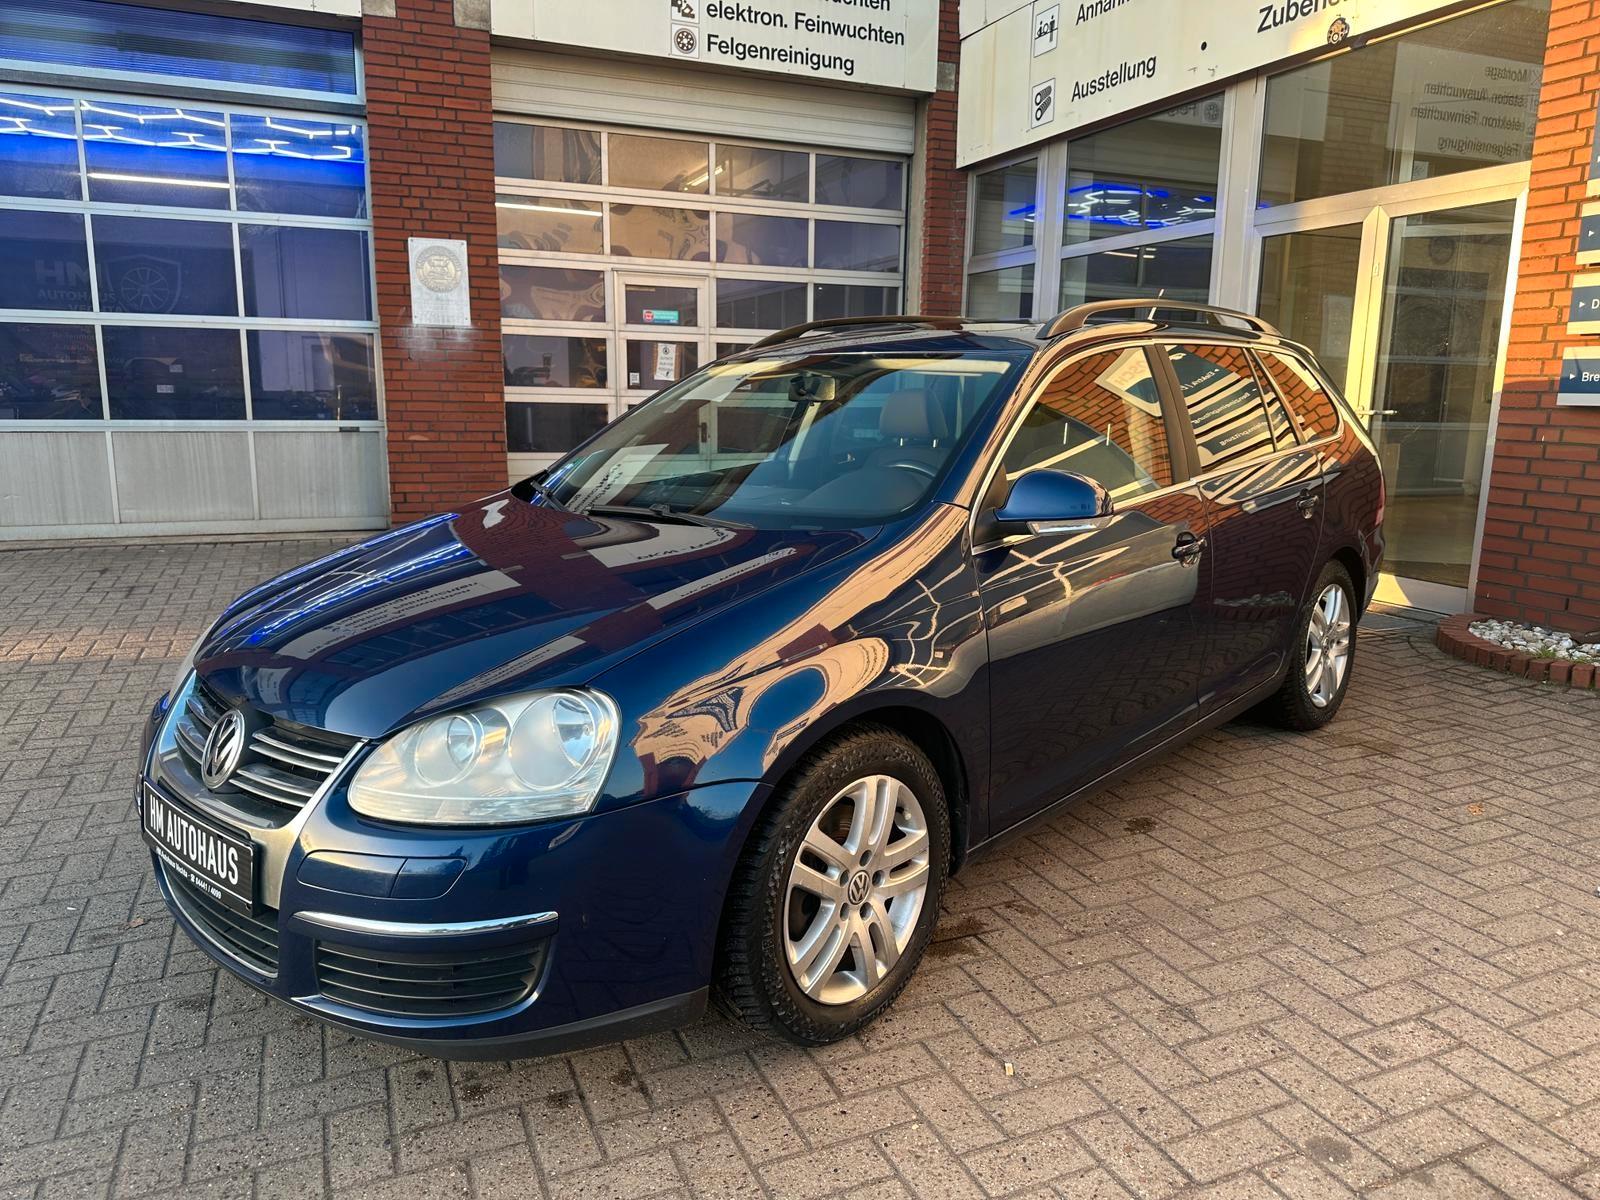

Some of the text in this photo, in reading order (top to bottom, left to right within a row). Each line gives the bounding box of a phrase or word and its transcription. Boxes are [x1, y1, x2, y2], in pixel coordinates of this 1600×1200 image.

[706, 1, 905, 46] elektron. Feinwuchten
[706, 34, 855, 76] Felgenreinigung
[1071, 54, 1157, 103] Ausstellung
[149, 794, 239, 886] HM AUTOHAUS
